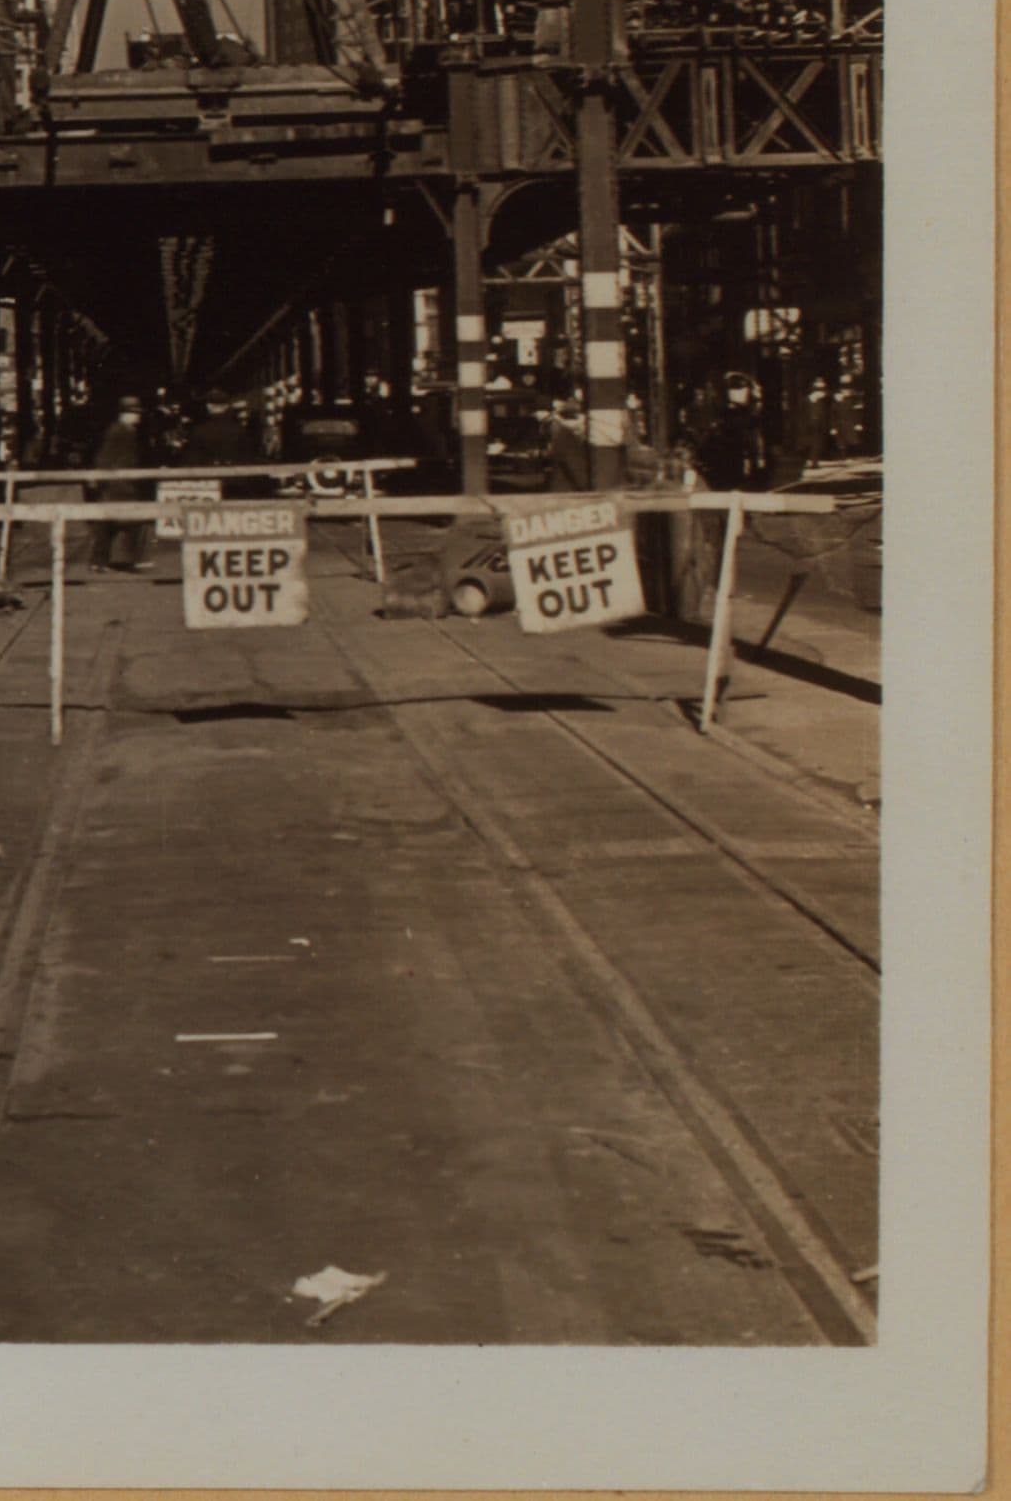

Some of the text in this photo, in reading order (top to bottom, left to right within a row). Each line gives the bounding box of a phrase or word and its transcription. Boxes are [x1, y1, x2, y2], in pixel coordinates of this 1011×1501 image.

[186, 509, 295, 538] DANGER
[509, 502, 618, 544] DANGER
[199, 549, 290, 578] KEEP
[527, 543, 618, 584] KEEP
[203, 584, 281, 613] OUT
[537, 578, 614, 619] OUT
